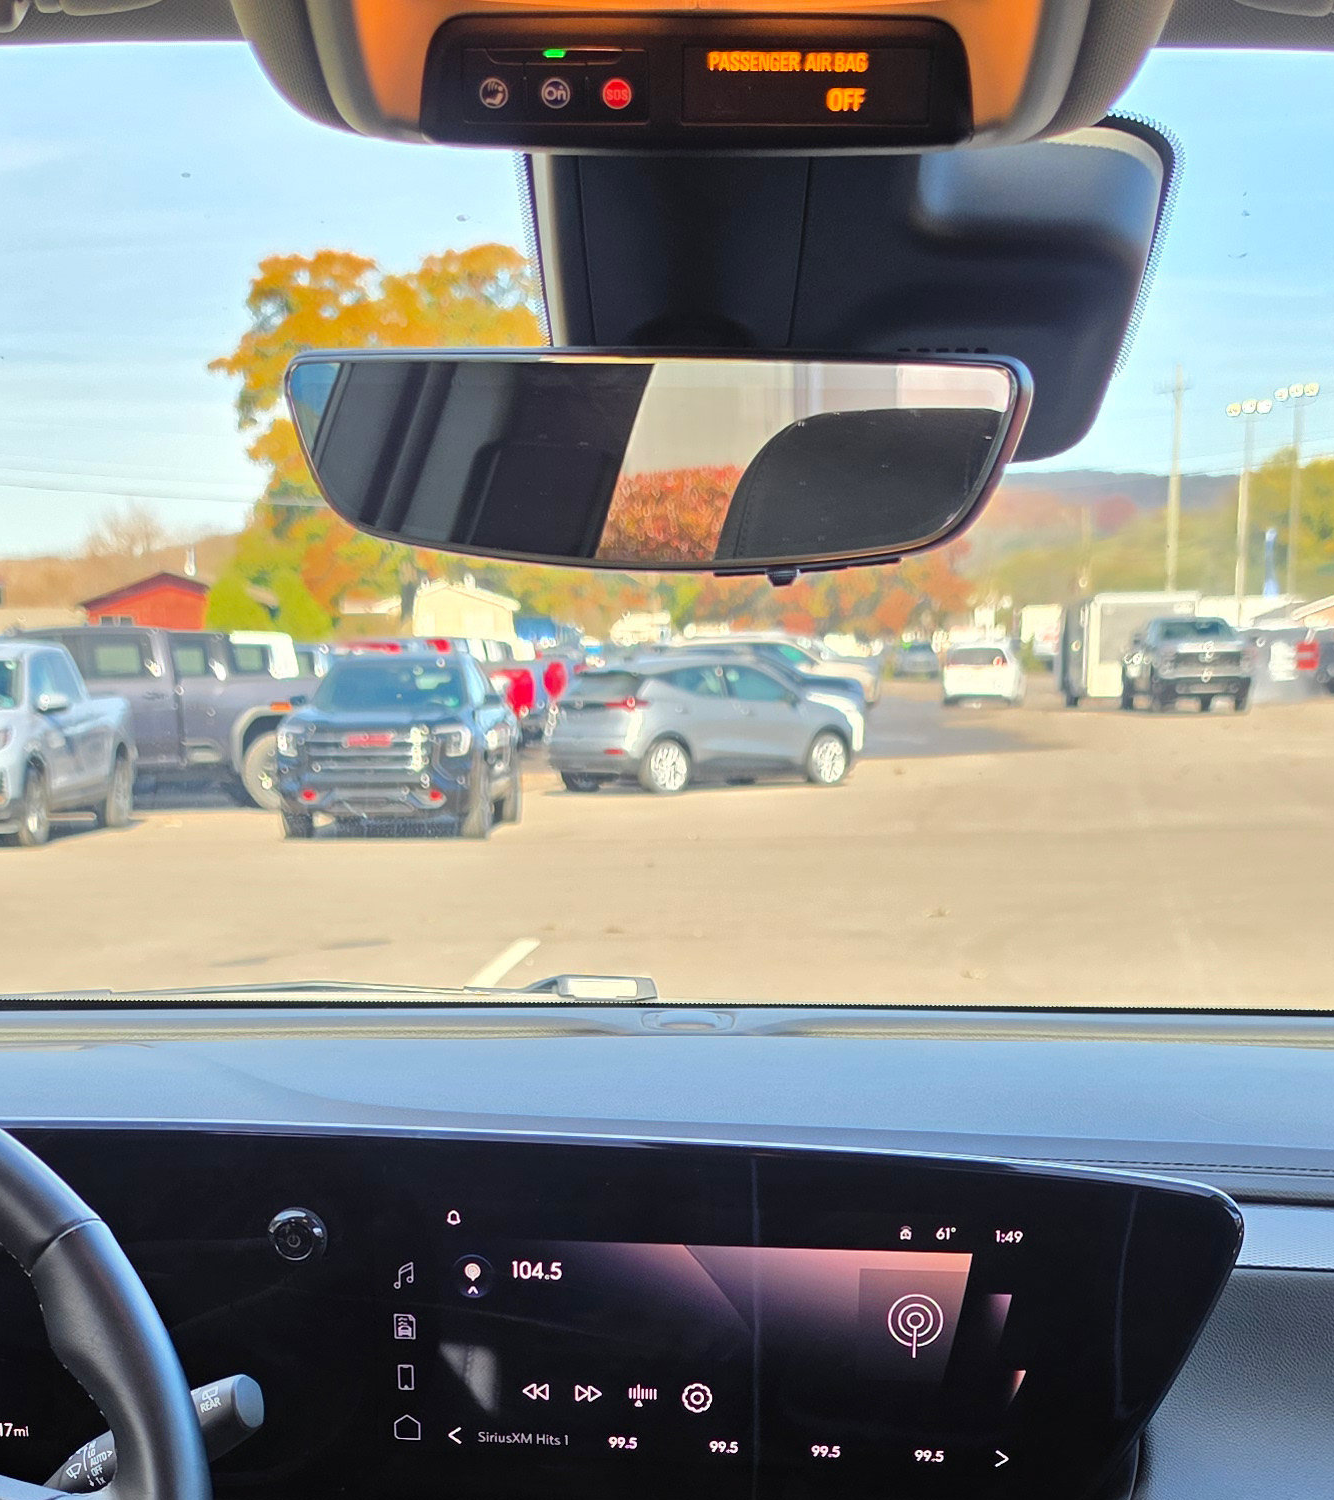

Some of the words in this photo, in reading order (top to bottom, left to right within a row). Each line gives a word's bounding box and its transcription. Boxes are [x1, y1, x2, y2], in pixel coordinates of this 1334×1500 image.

[708, 51, 802, 72] PASSENGER
[804, 52, 832, 71] AIR
[834, 52, 868, 73] BAG
[606, 87, 629, 101] SOS
[826, 88, 866, 112] OFF
[994, 1229, 1024, 1244] 1:49
[511, 1260, 563, 1281] 104.5
[199, 1396, 222, 1413] REAR
[477, 1431, 534, 1445] SiriusXM
[535, 1433, 562, 1447] Hits
[608, 1436, 638, 1450] 99.5
[709, 1440, 740, 1454] 99.5
[811, 1444, 841, 1459] 99.5
[90, 1451, 108, 1468] AUTO
[914, 1449, 945, 1464] 99.5
[90, 1463, 103, 1477] OFF
